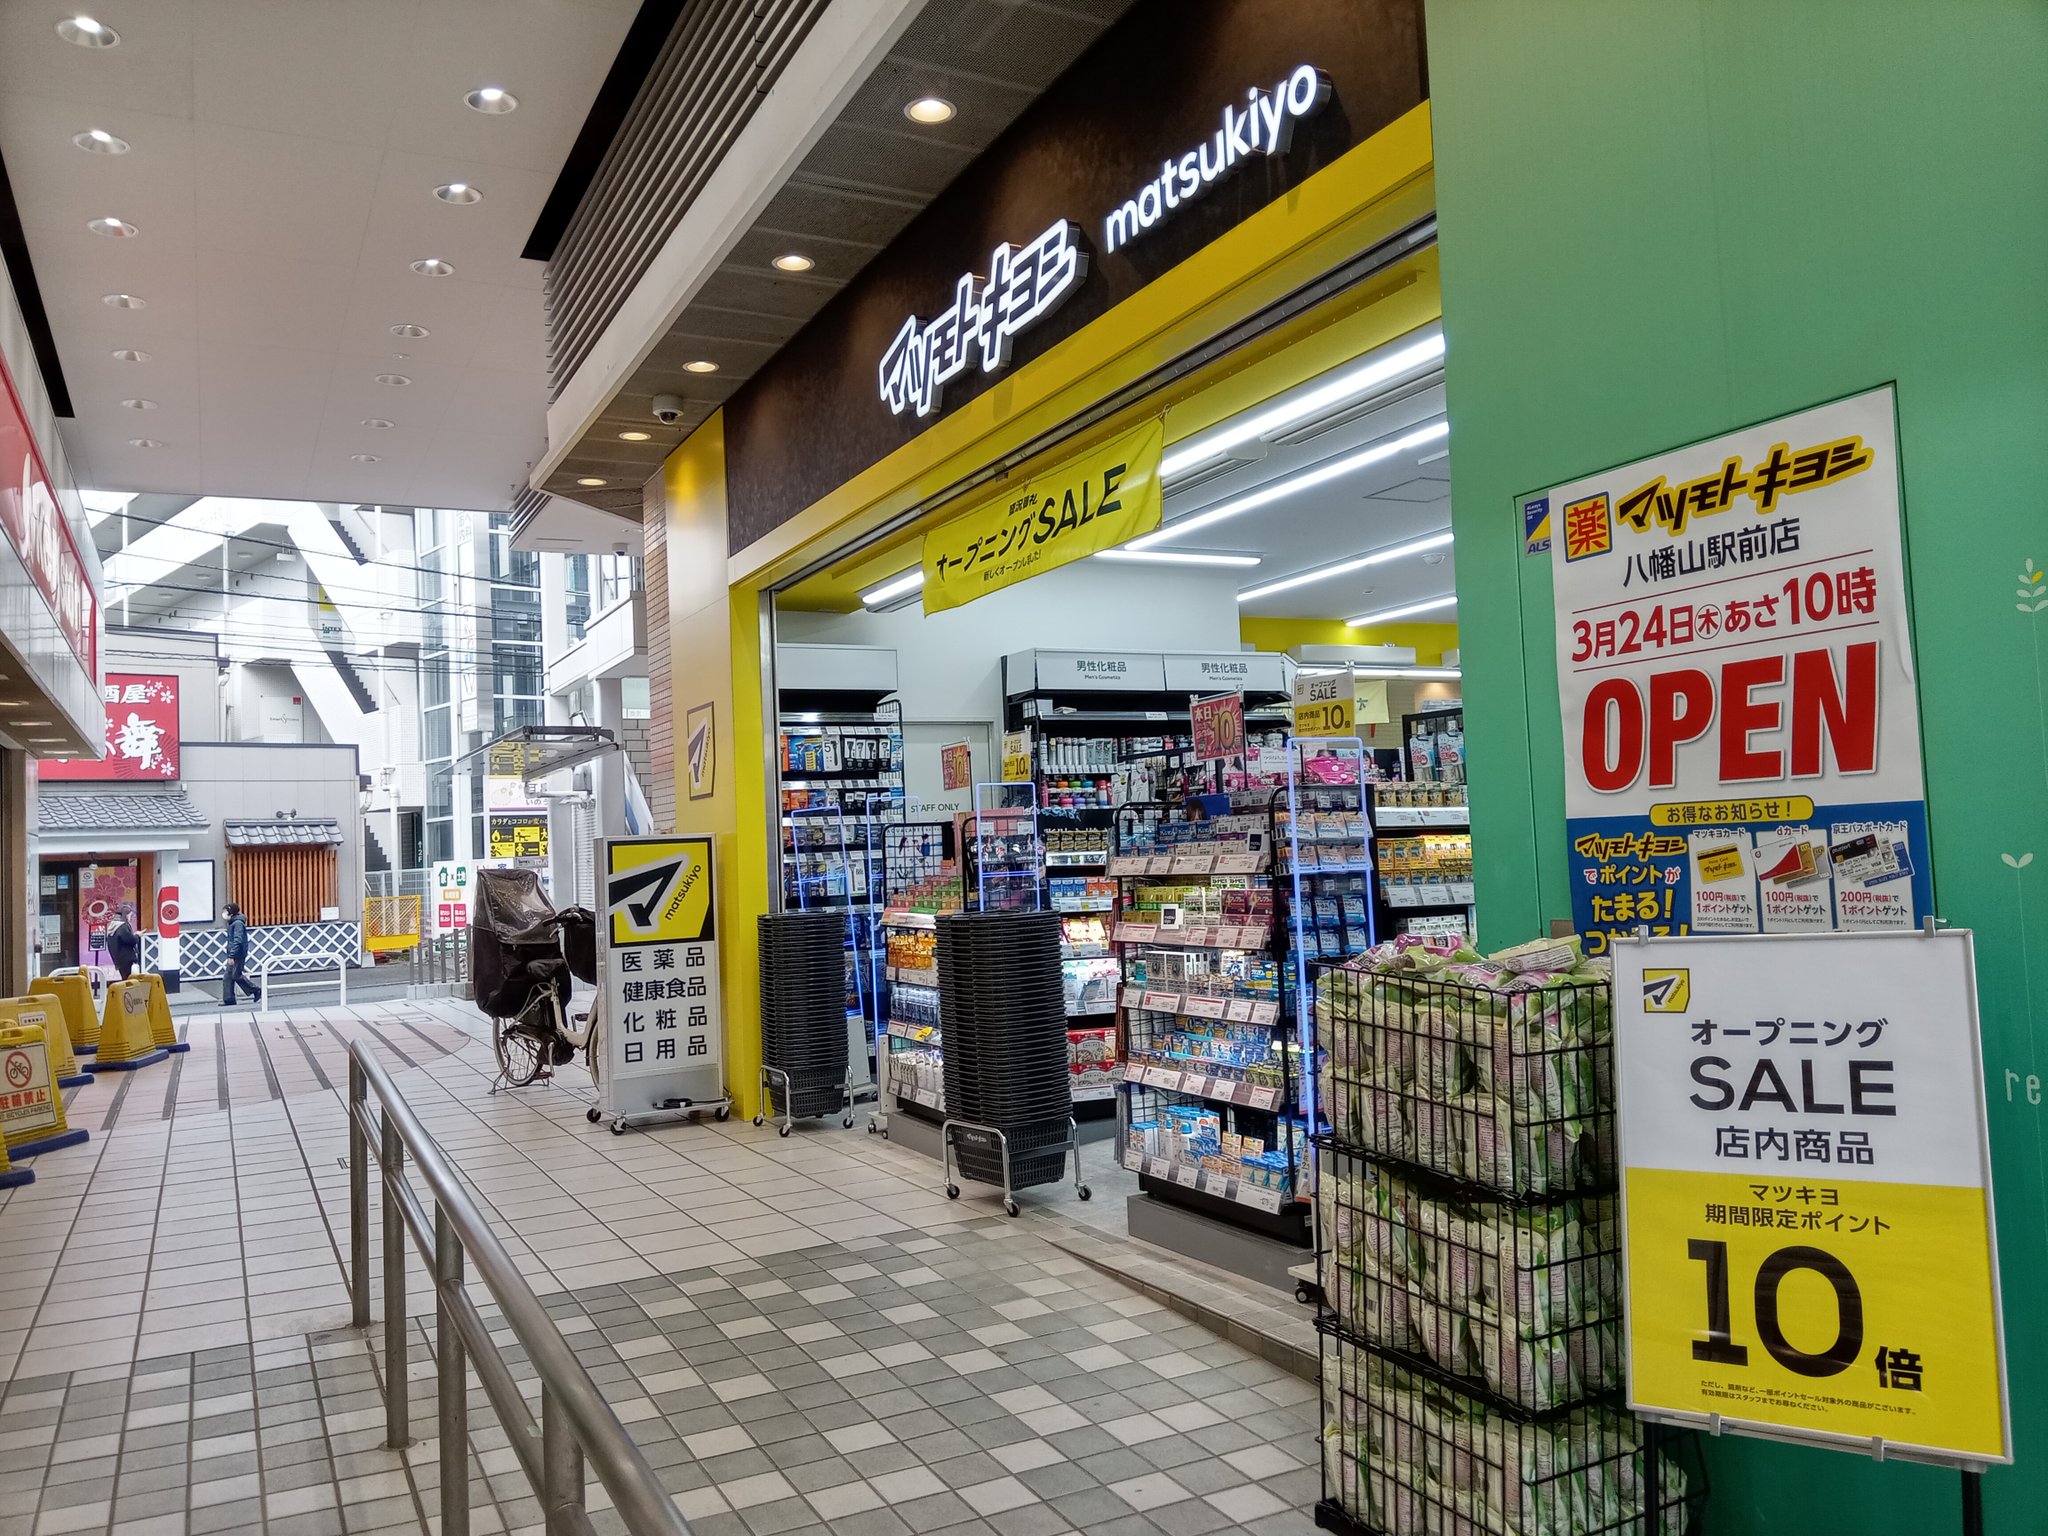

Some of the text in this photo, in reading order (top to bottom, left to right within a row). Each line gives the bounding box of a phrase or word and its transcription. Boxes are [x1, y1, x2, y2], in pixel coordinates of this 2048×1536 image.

[1106, 64, 1317, 254] matsukiyo
[879, 218, 1077, 417] マツモトキヨシ
[1618, 440, 1868, 531] マツモトキヨシ
[1567, 501, 1607, 556] 薬
[1528, 540, 1551, 554] ALS
[1623, 517, 1800, 588] 八幡山駅前店
[1076, 660, 1127, 673] 男性化粧品
[1201, 663, 1248, 674] 男性化粧品
[1310, 686, 1337, 701] SALE
[1582, 641, 1879, 793] OPEN
[910, 803, 960, 813] STAFF ONLY
[1694, 828, 1745, 838] マツキヨカード
[1777, 826, 1808, 836] dカード
[1832, 821, 1907, 833] 京王パスポートカード
[1577, 834, 1685, 860] マツモトキヨシ
[1584, 864, 1681, 884] でポイントが
[664, 863, 702, 921] matsukiyo
[1697, 903, 1752, 914] 1ポイントゲット
[1766, 904, 1826, 915] 1ポイントゲット
[1841, 905, 1907, 916] 1ポイントゲット
[621, 946, 706, 973] 医薬品
[622, 976, 707, 1003] 健康食品
[623, 1006, 708, 1034] 化粧品
[1690, 1017, 1889, 1048] オープニング
[624, 1035, 708, 1063] 日用品
[1688, 1055, 1897, 1117] SALE
[1715, 1125, 1875, 1165] 店内商品
[1749, 1184, 1839, 1207] マツキヨ
[1705, 1203, 1892, 1236] 期間限定ポイント
